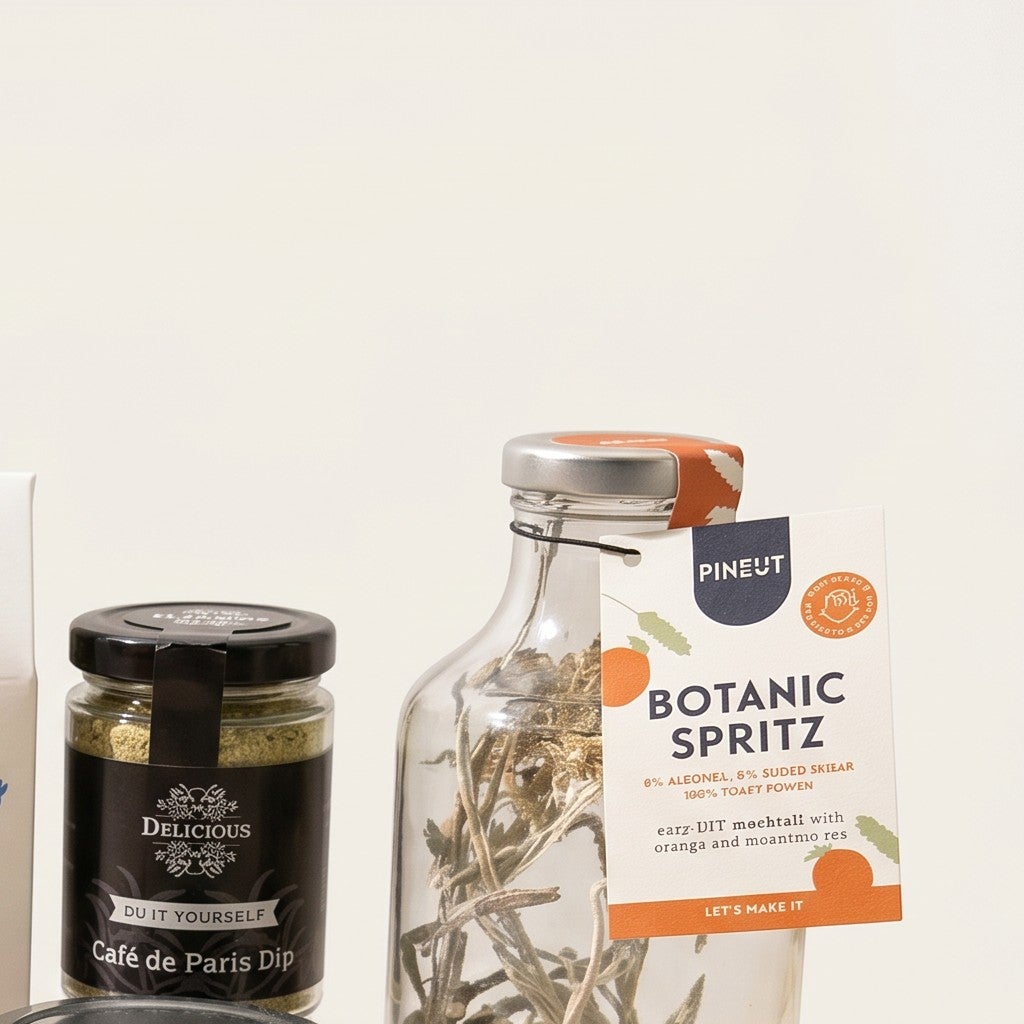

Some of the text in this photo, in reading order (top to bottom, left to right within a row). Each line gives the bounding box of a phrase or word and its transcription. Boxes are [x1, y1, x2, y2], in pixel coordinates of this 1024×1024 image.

[648, 671, 846, 720] BOTANIC
[671, 715, 824, 760] SPRITZ
[762, 765, 806, 779] SUDED
[141, 816, 251, 839] DELICIOUS
[810, 811, 844, 825] with
[654, 841, 706, 854] oranga
[712, 835, 740, 849] and
[824, 830, 847, 841] res
[124, 905, 265, 924] DU IT YOURSELF
[705, 900, 804, 918] LET'S MAKE IT
[92, 940, 294, 974] Café de Paris Dip
